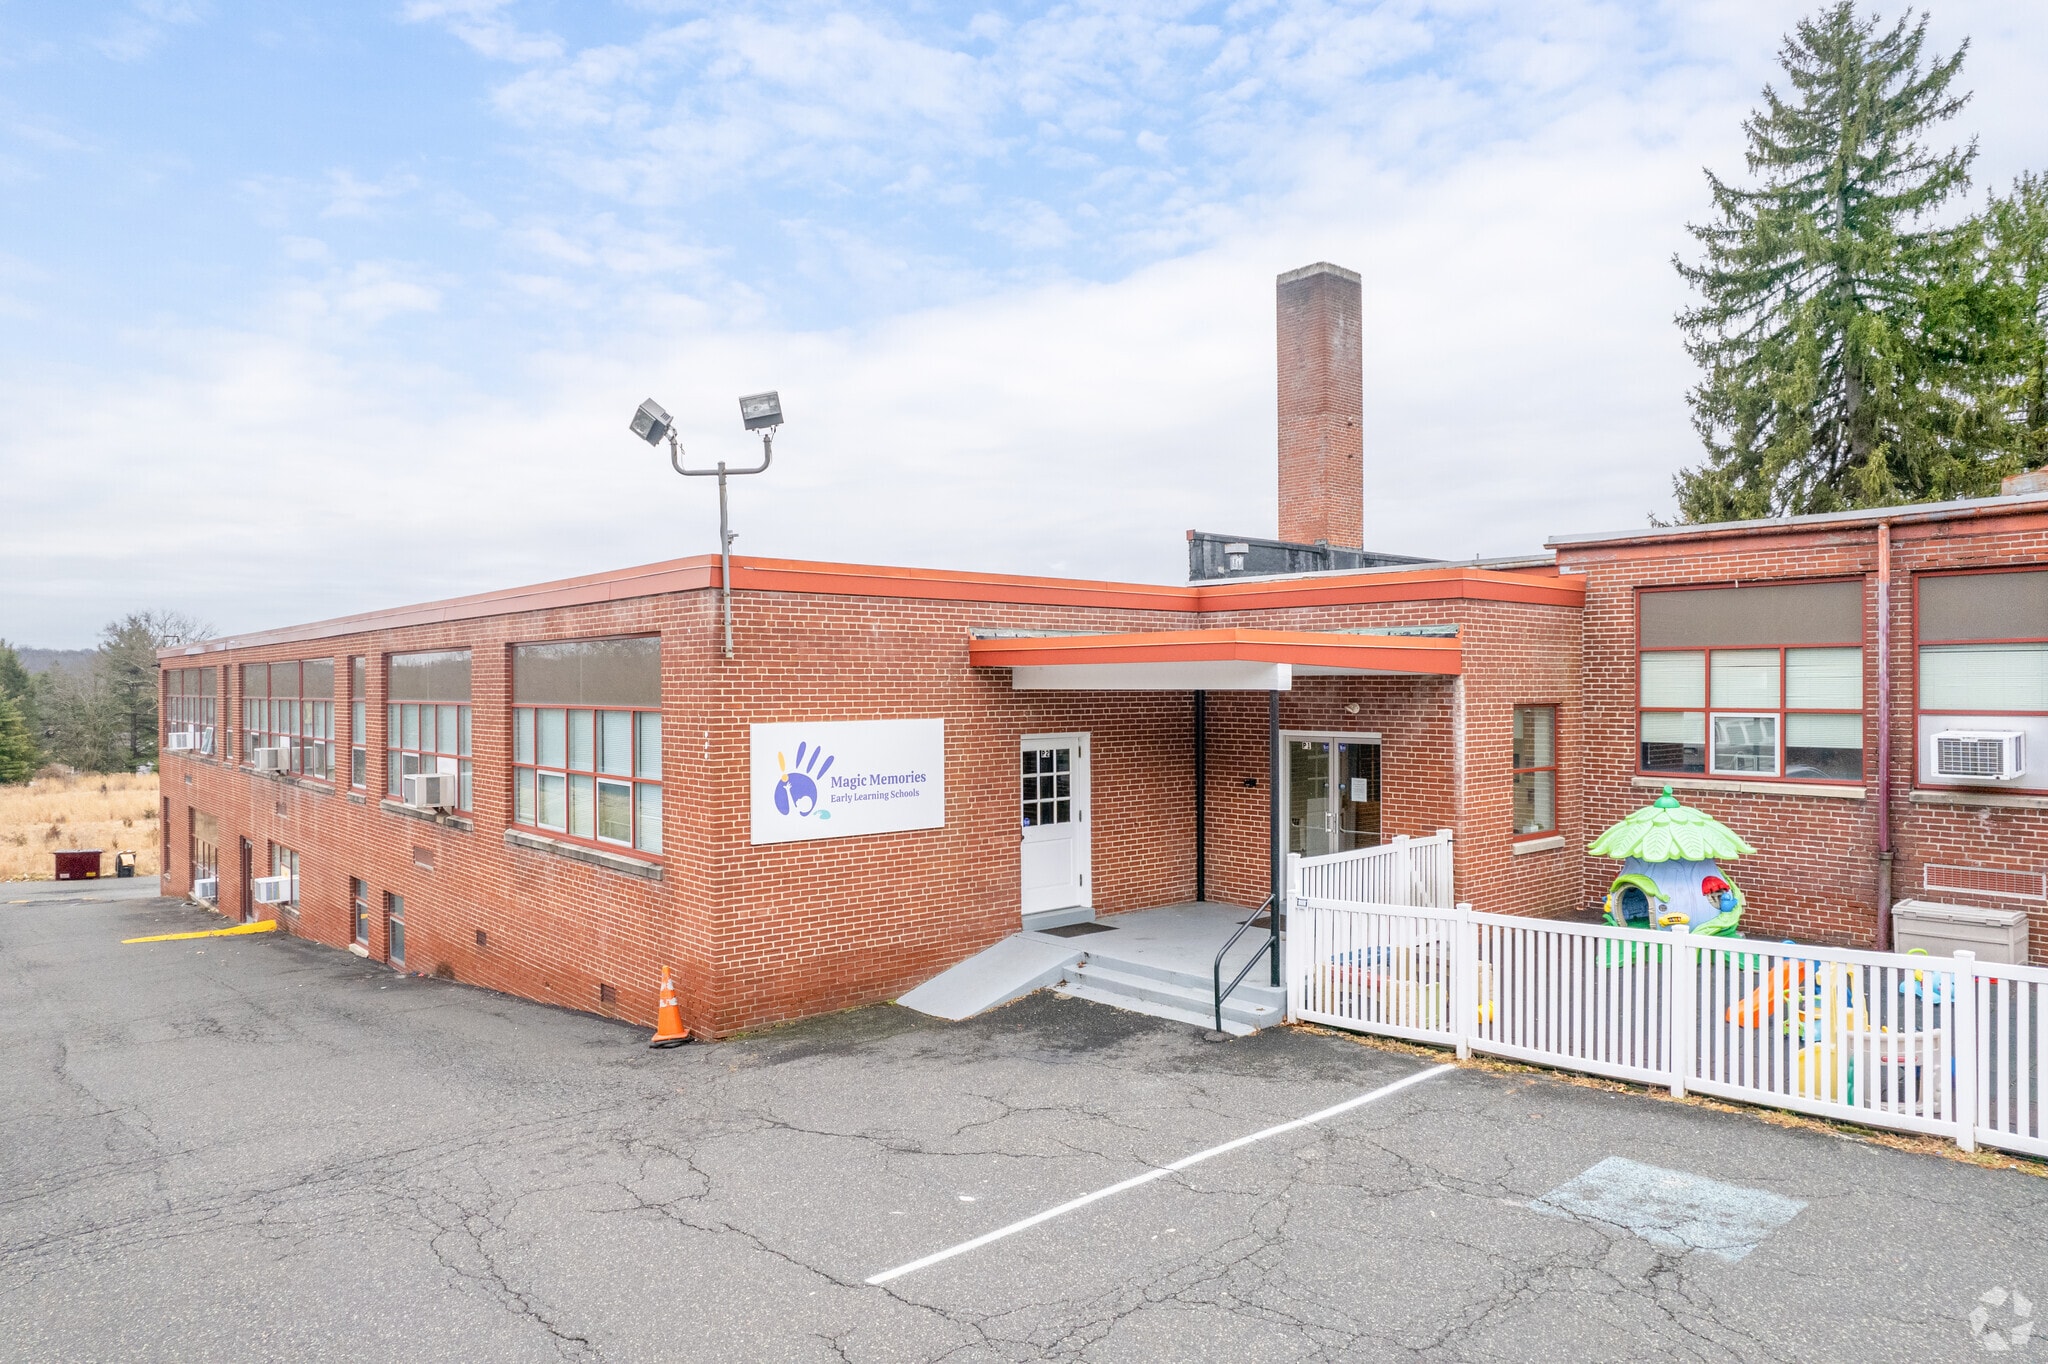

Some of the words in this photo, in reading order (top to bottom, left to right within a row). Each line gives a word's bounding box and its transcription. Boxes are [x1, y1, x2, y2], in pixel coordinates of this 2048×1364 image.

[831, 774, 867, 790] Magic
[869, 770, 927, 786] Memories
[831, 793, 853, 803] Early
[854, 791, 889, 801] Learning
[890, 788, 920, 798] Schools
